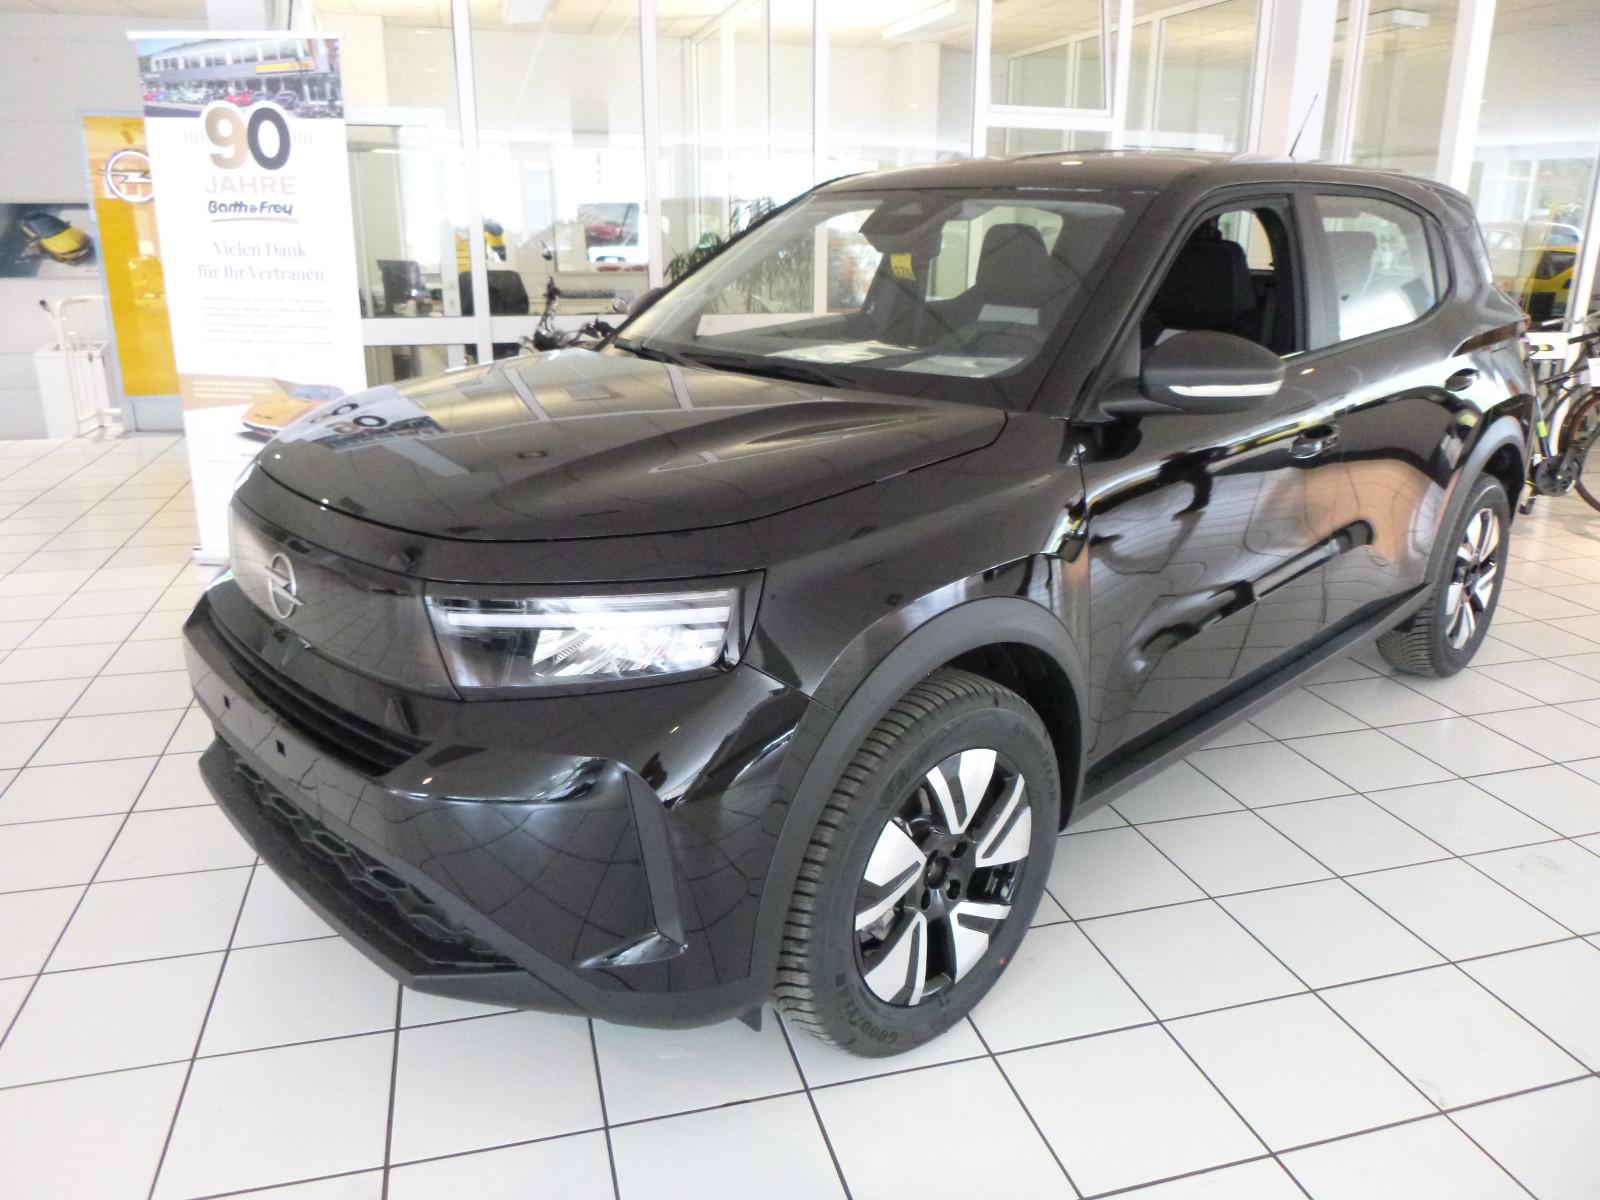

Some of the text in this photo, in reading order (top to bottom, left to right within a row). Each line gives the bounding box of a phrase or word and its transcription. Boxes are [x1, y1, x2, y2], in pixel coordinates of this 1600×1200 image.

[205, 106, 291, 171] 90
[205, 175, 296, 195] JAHRE
[213, 240, 307, 258] Vielen Dank
[197, 264, 221, 280] für
[223, 264, 247, 280] Ihr
